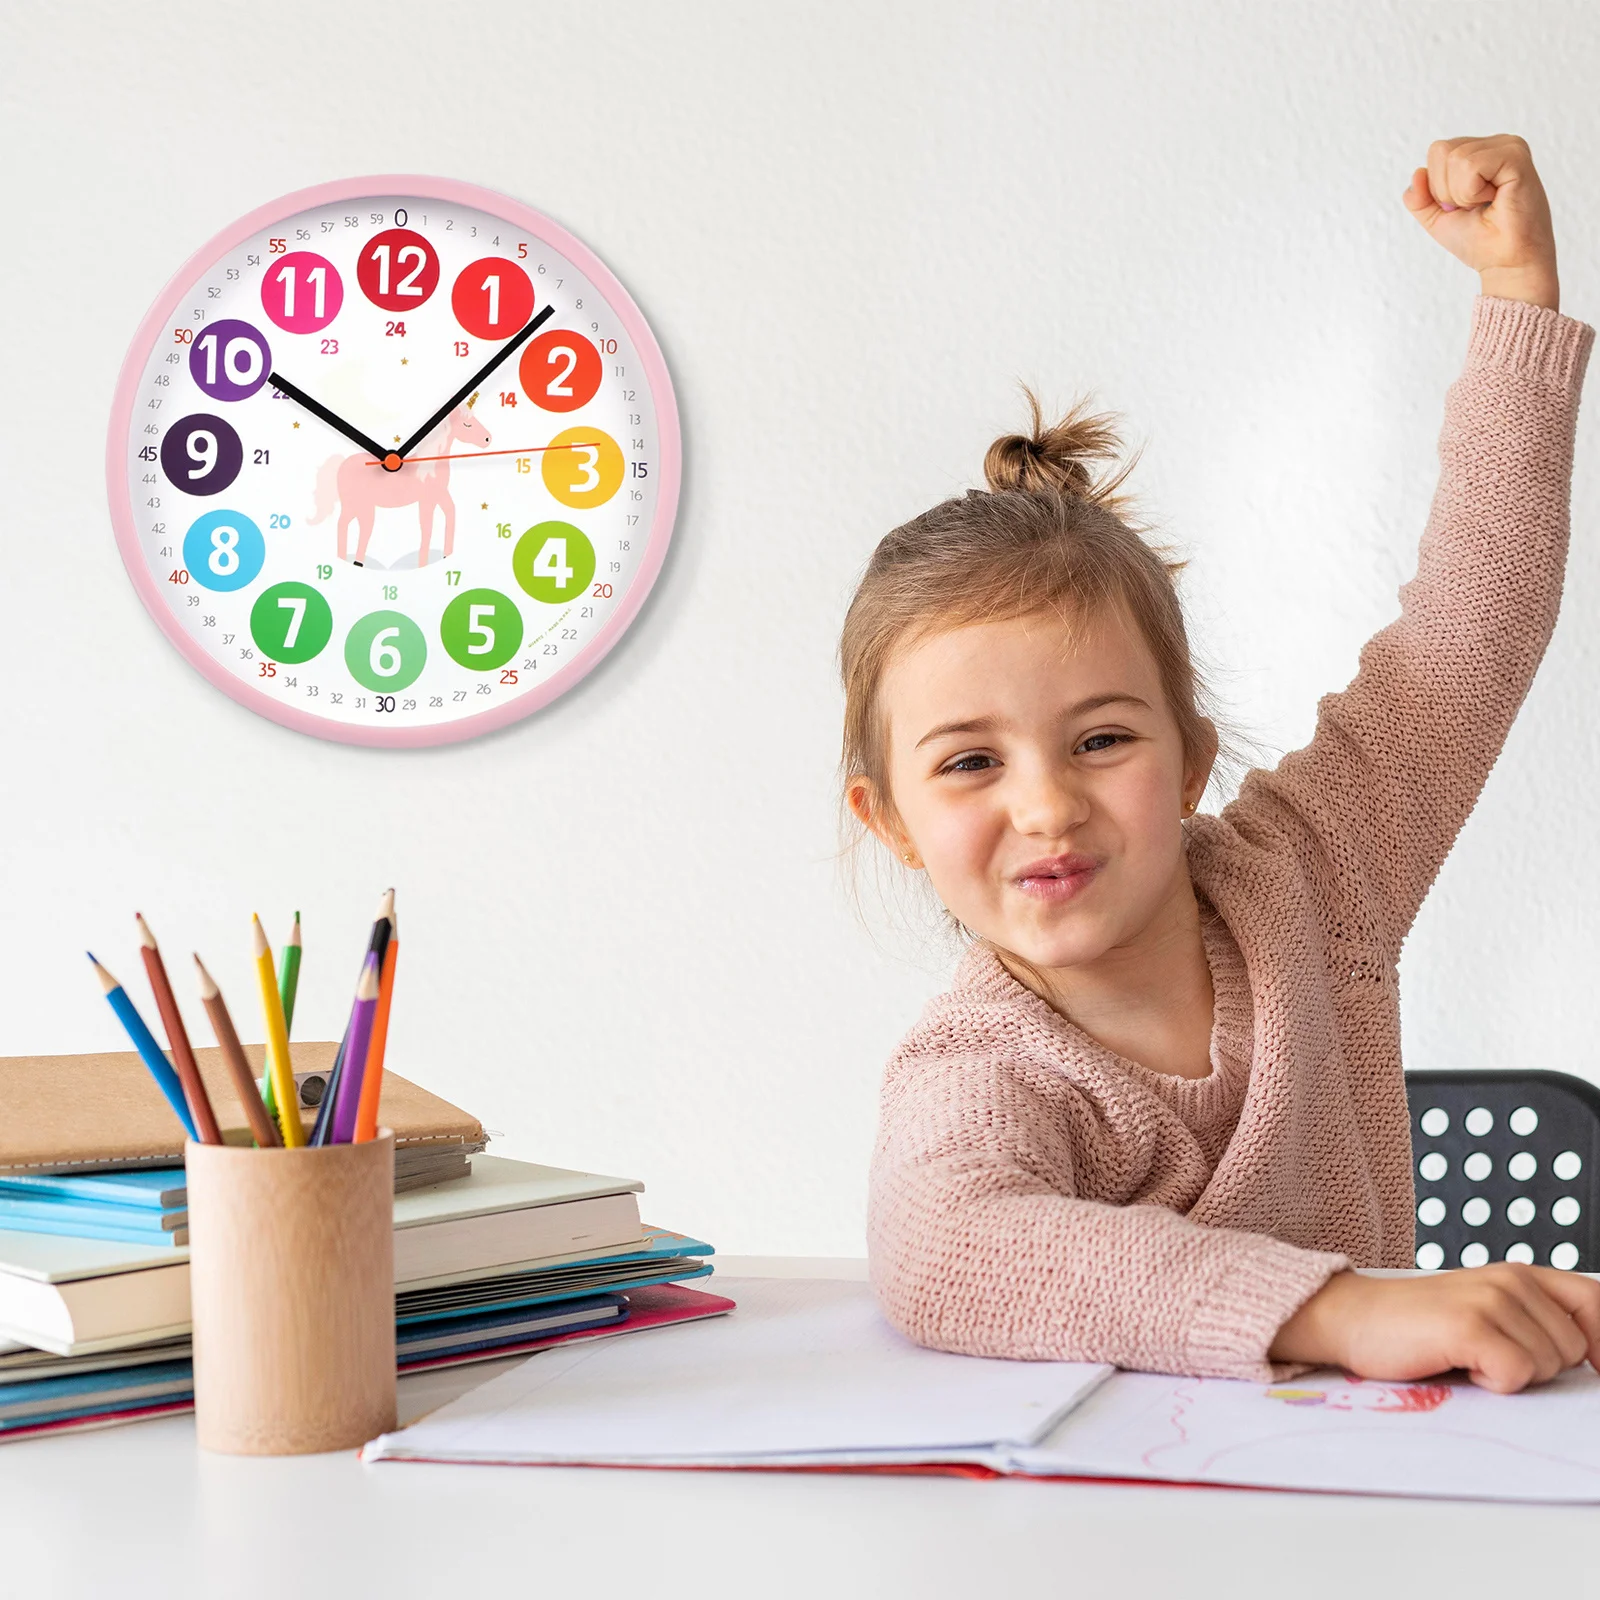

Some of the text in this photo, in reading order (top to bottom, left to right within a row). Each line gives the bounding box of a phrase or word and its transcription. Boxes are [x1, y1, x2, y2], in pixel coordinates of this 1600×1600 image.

[344, 216, 359, 228] 58
[370, 214, 384, 224] 59
[394, 209, 408, 227] 0
[423, 215, 428, 225] 1
[321, 221, 335, 233] 57
[446, 220, 453, 231] 2
[296, 229, 311, 241] 56
[470, 227, 477, 238] 3
[269, 238, 287, 253] 55
[493, 236, 500, 247] 4
[518, 243, 528, 258] 5
[247, 255, 261, 266] 54
[226, 269, 240, 280] 53
[370, 244, 426, 296] 12
[538, 264, 546, 275] 6
[556, 279, 563, 289] 7
[208, 287, 221, 299] 52
[275, 266, 326, 318] 11
[480, 275, 500, 325] 1
[575, 299, 583, 309] 8
[193, 309, 205, 321] 51
[386, 321, 406, 337] 24
[591, 322, 599, 332] 9
[174, 329, 193, 344] 50
[320, 339, 339, 355] 23
[454, 341, 469, 357] 13
[600, 339, 617, 354] 10
[166, 353, 180, 365] 49
[198, 334, 264, 386] 10
[546, 346, 577, 397] 2
[615, 366, 625, 377] 11
[154, 375, 170, 386] 48
[499, 392, 517, 408] 14
[623, 390, 636, 401] 12
[148, 399, 162, 410] 47
[629, 414, 641, 425] 13
[144, 424, 159, 435] 46
[632, 439, 644, 449] 14
[138, 446, 157, 461] 45
[185, 429, 218, 481] 9
[253, 449, 270, 465] 21
[515, 458, 530, 473] 15
[569, 440, 600, 493] 3
[631, 462, 648, 479] 15
[142, 474, 157, 484] 44
[630, 490, 643, 501] 16
[147, 498, 161, 508] 43
[270, 514, 291, 529] 20
[626, 515, 639, 526] 17
[152, 523, 166, 534] 42
[496, 523, 511, 539] 16
[208, 525, 240, 576] 8
[619, 540, 630, 551] 18
[160, 547, 173, 557] 41
[533, 538, 574, 589] 4
[609, 562, 621, 573] 19
[168, 569, 189, 585] 40
[316, 565, 333, 580] 19
[445, 571, 461, 586] 17
[382, 585, 398, 600] 18
[592, 584, 613, 598] 20
[186, 596, 200, 606] 39
[581, 607, 593, 618] 21
[203, 616, 216, 627] 38
[277, 597, 307, 648] 7
[467, 604, 496, 655] 5
[561, 629, 578, 640] 22
[222, 634, 235, 645] 37
[239, 649, 253, 660] 36
[369, 627, 402, 677] 6
[543, 644, 558, 655] 23
[258, 663, 277, 677] 35
[524, 659, 537, 670] 24
[284, 677, 297, 688] 34
[500, 670, 518, 685] 25
[306, 686, 319, 697] 33
[477, 684, 491, 695] 26
[330, 693, 343, 704] 32
[429, 696, 443, 707] 28
[453, 691, 467, 702] 27
[355, 698, 366, 708] 31
[375, 696, 396, 713] 30
[402, 699, 417, 710] 29
